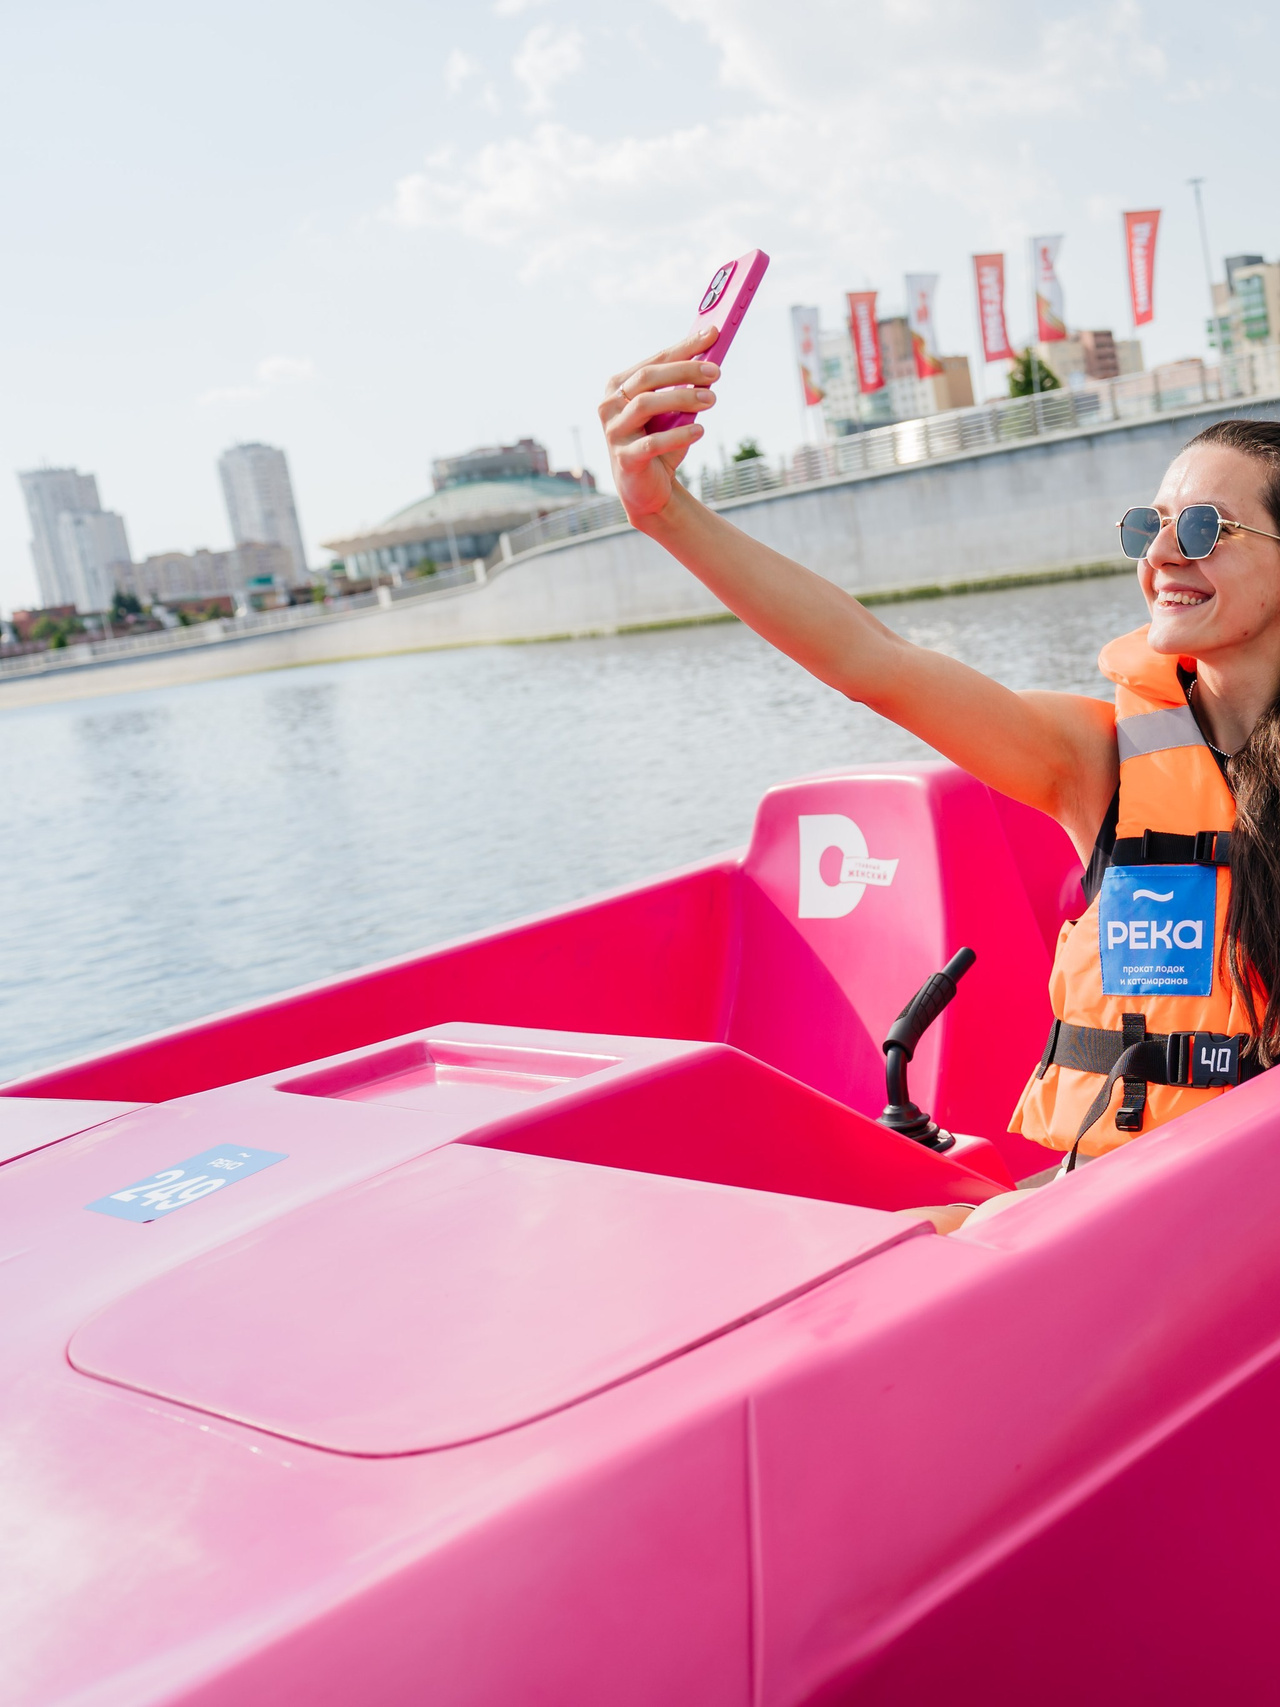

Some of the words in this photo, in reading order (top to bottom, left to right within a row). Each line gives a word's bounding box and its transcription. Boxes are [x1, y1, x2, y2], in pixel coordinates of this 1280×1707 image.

[1122, 965, 1154, 976] прокат
[1155, 965, 1185, 975] лодок
[1127, 977, 1188, 988] катамаранов
[1200, 1046, 1232, 1073] 40
[109, 1169, 226, 1211] 249
